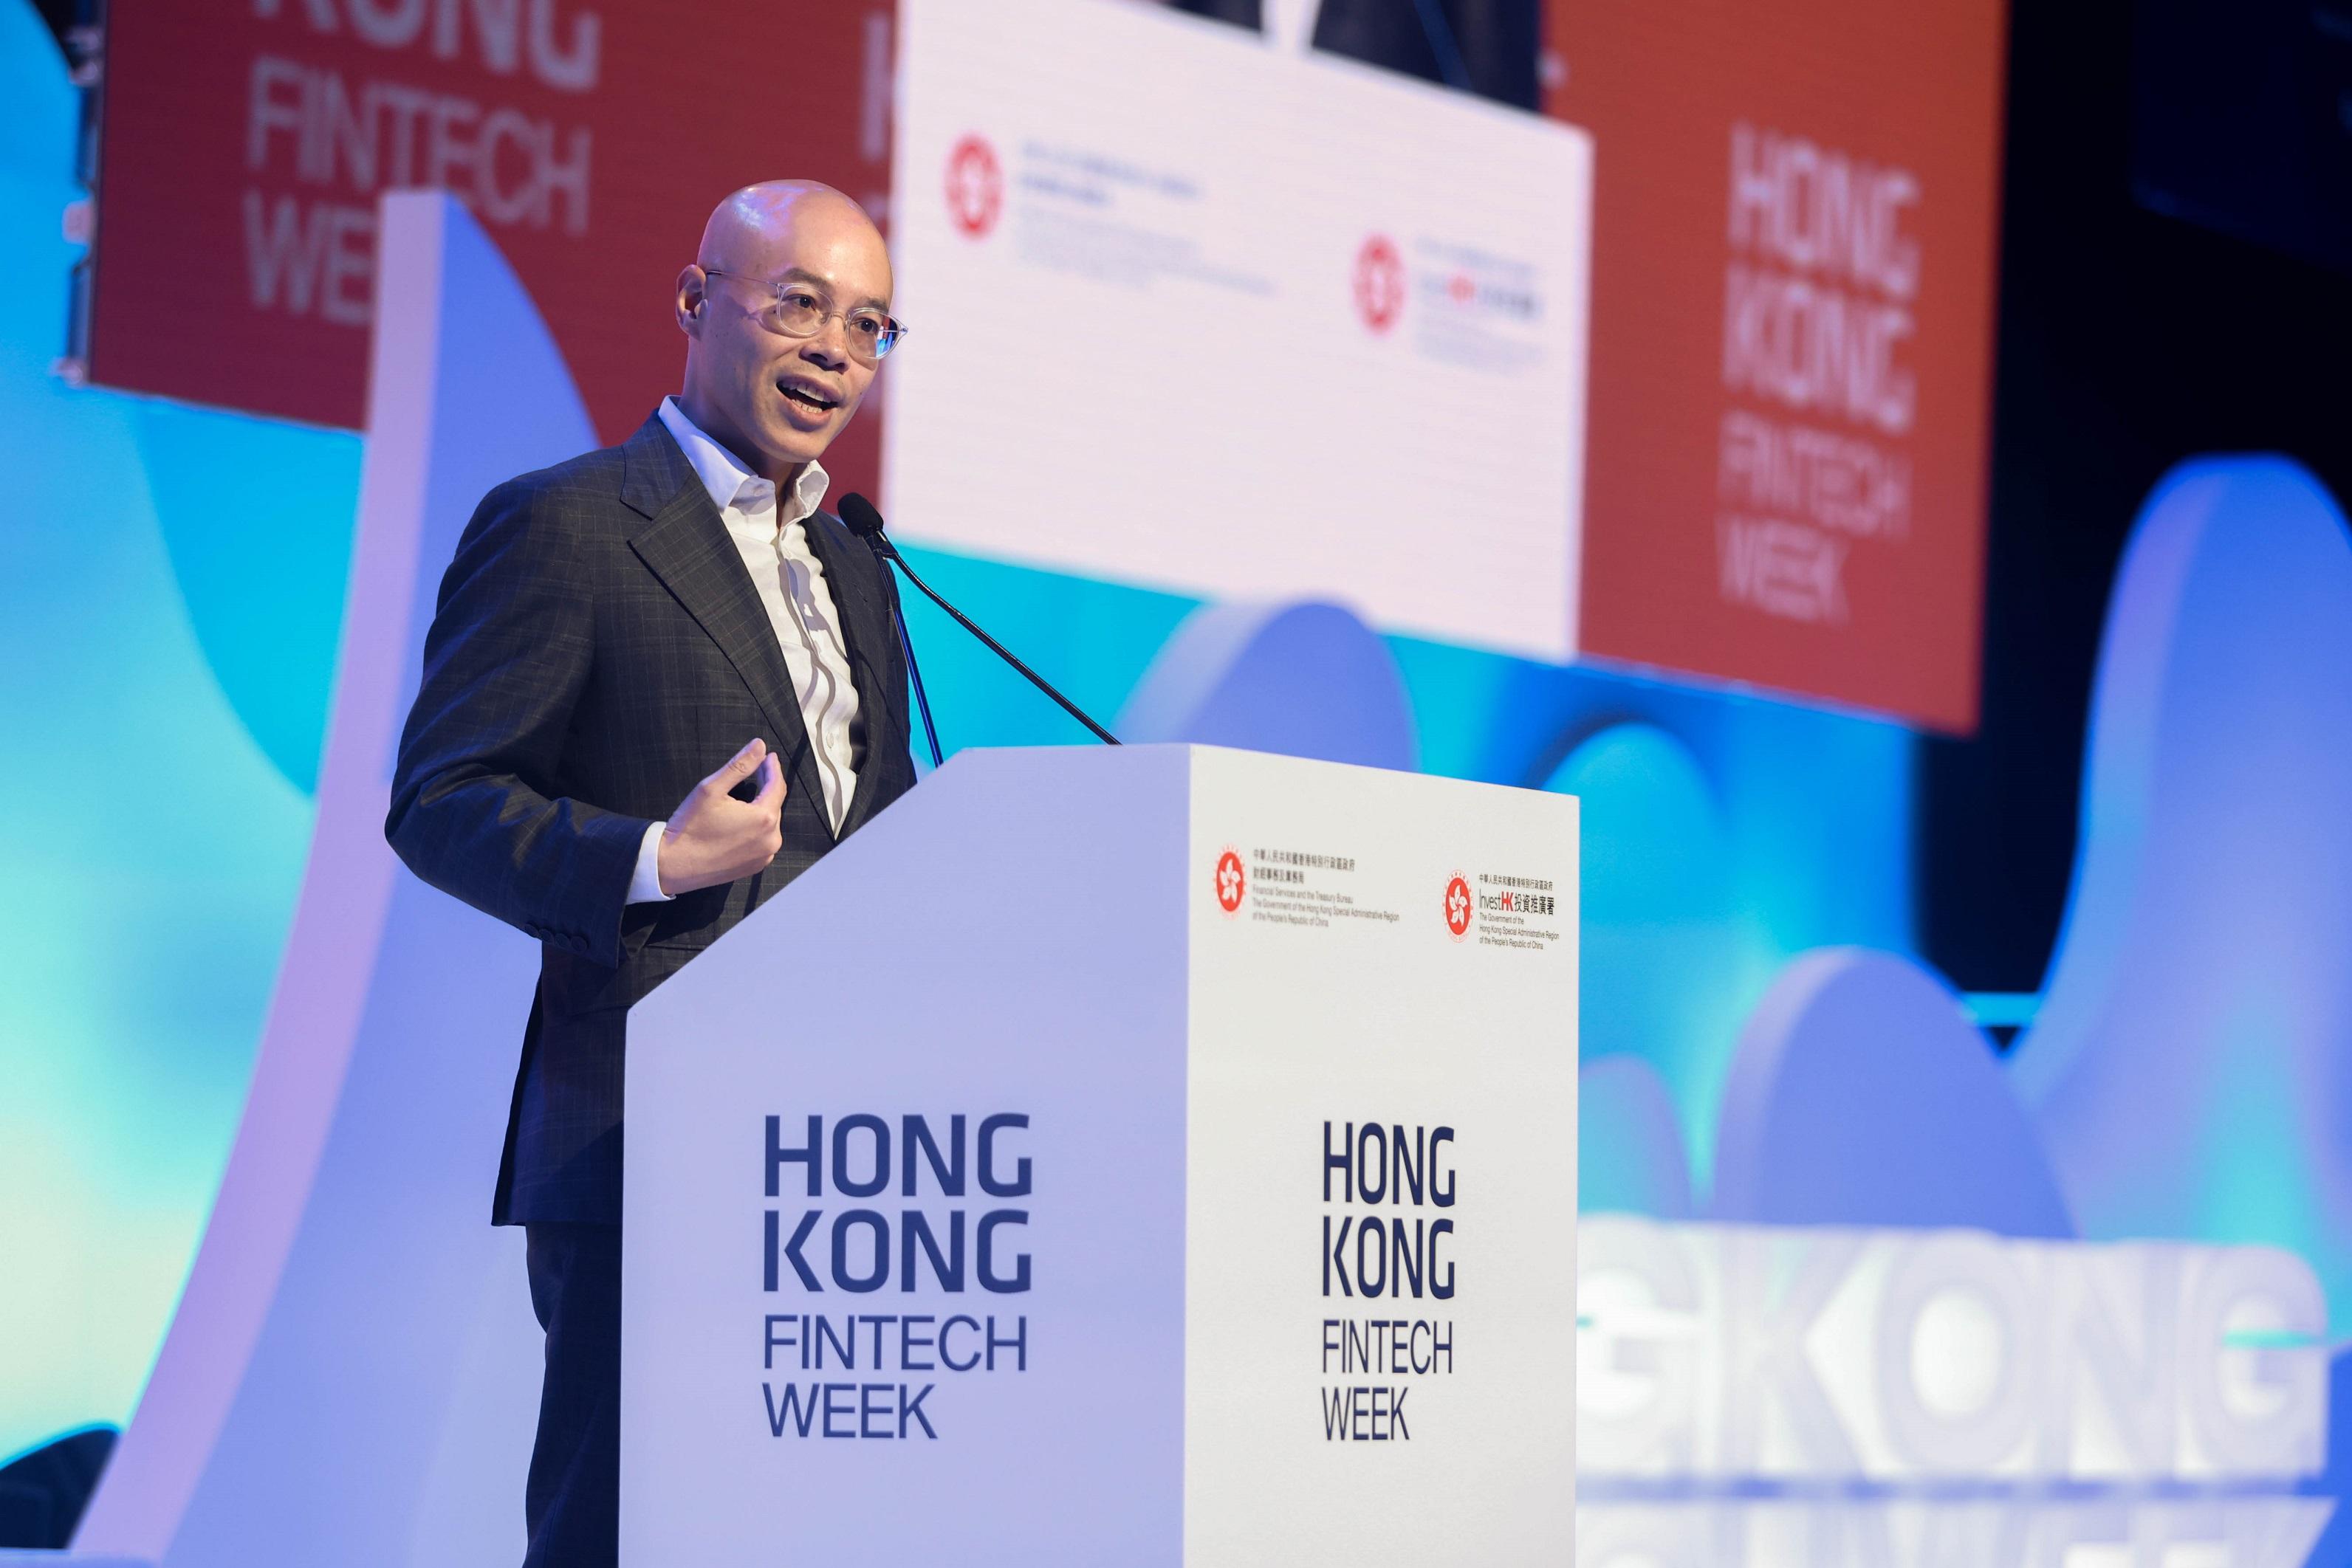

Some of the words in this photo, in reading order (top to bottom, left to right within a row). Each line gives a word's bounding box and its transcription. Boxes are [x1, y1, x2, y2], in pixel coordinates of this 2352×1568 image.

[246, 53, 592, 237] FINTECH
[1728, 120, 1921, 297] HONG
[244, 188, 380, 326] WE
[1721, 260, 1917, 436] KONG
[1718, 408, 1913, 544] FINTECH
[1714, 512, 1851, 629] WEEK
[1479, 925, 1490, 935] Hong
[1491, 926, 1502, 935] Kong
[1546, 931, 1560, 941] Region
[1515, 892, 1554, 915] 投資推廣署
[1532, 941, 1543, 949] China
[764, 1113, 1032, 1197] HONG
[1323, 1120, 1456, 1208] HONG
[764, 1208, 1032, 1293] KONG
[1323, 1215, 1455, 1300] KONG
[764, 1314, 1026, 1371] FINTECH
[1323, 1318, 1453, 1375] FINTECH
[762, 1382, 938, 1440] WEEK
[1321, 1386, 1410, 1441] WEEK
